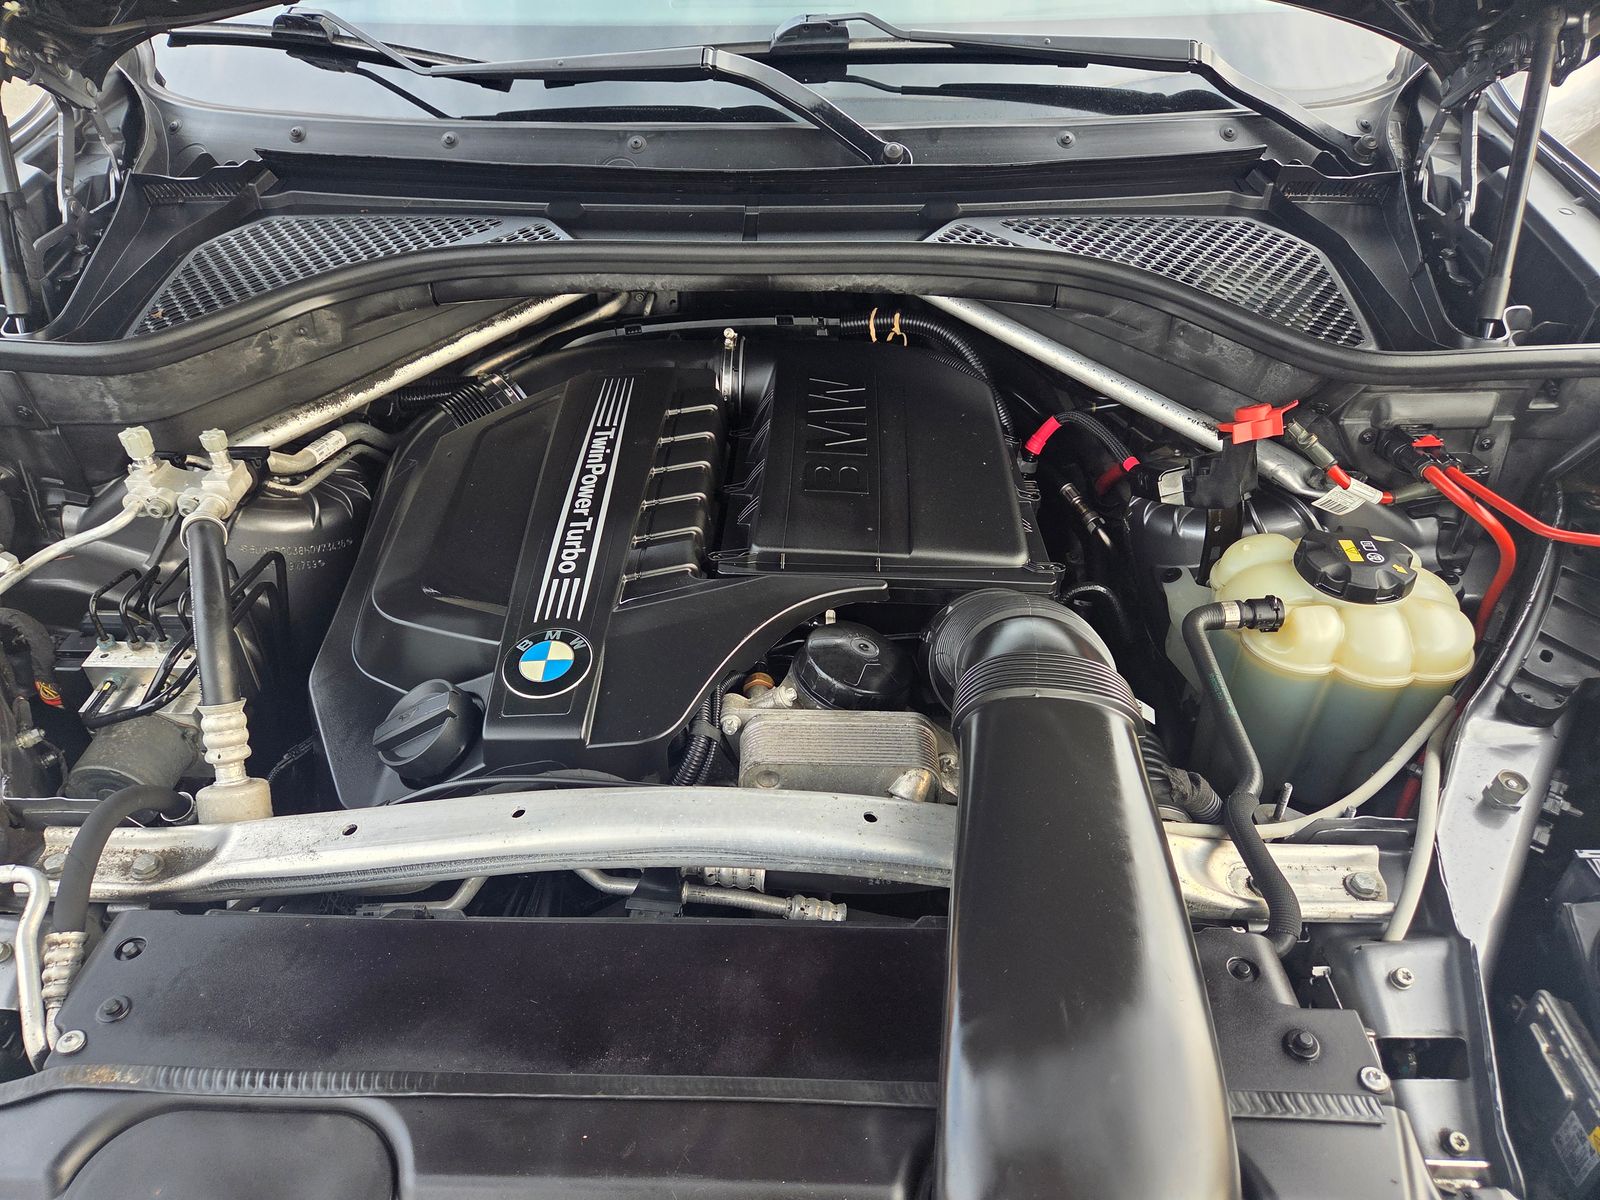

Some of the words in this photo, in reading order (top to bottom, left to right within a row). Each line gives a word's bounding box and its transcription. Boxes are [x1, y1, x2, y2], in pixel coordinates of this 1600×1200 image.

[573, 427, 616, 516] TwinPower
[804, 377, 869, 495] BMW
[557, 516, 594, 574] Turbo
[516, 630, 586, 652] BMW
